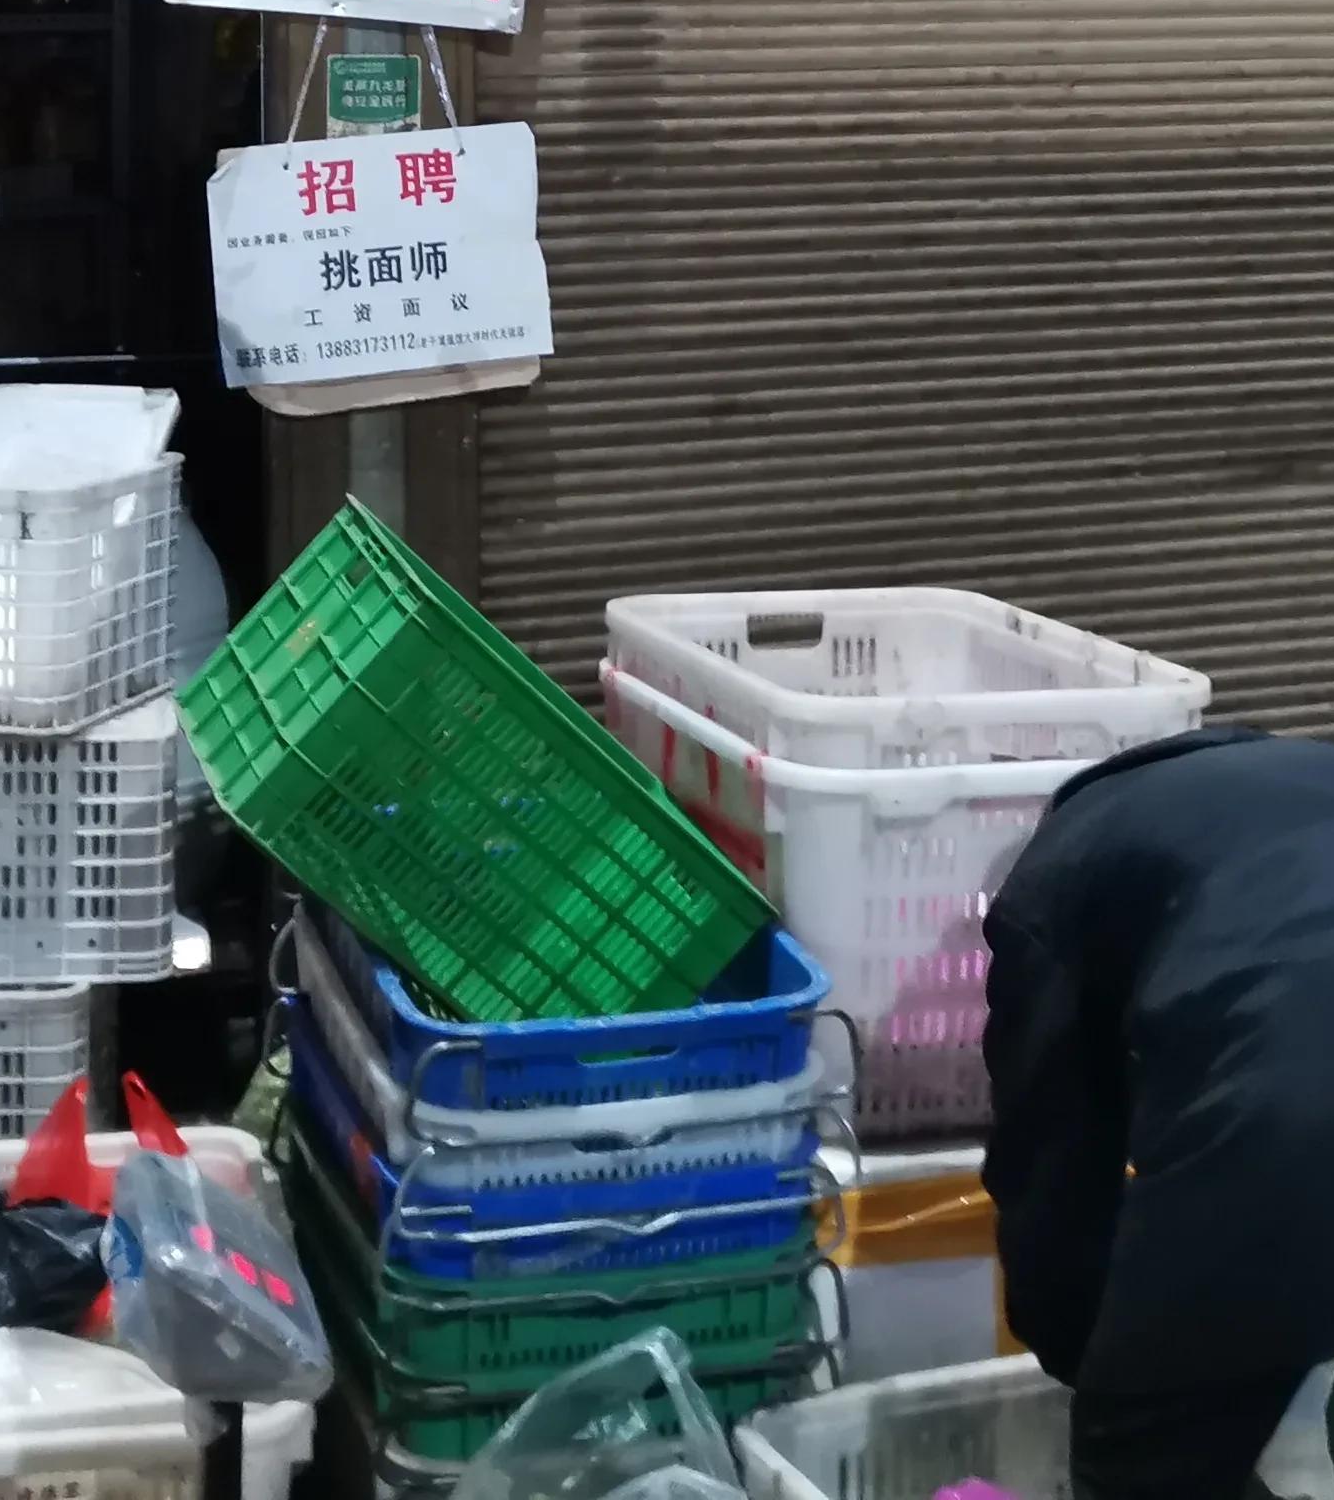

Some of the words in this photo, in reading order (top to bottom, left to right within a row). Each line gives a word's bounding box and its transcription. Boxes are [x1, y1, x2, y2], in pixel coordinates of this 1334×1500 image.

[297, 148, 457, 215] 招聘
[319, 241, 448, 291] 挑面师
[303, 292, 469, 326] 工资面议
[316, 332, 416, 360] 13883173112
